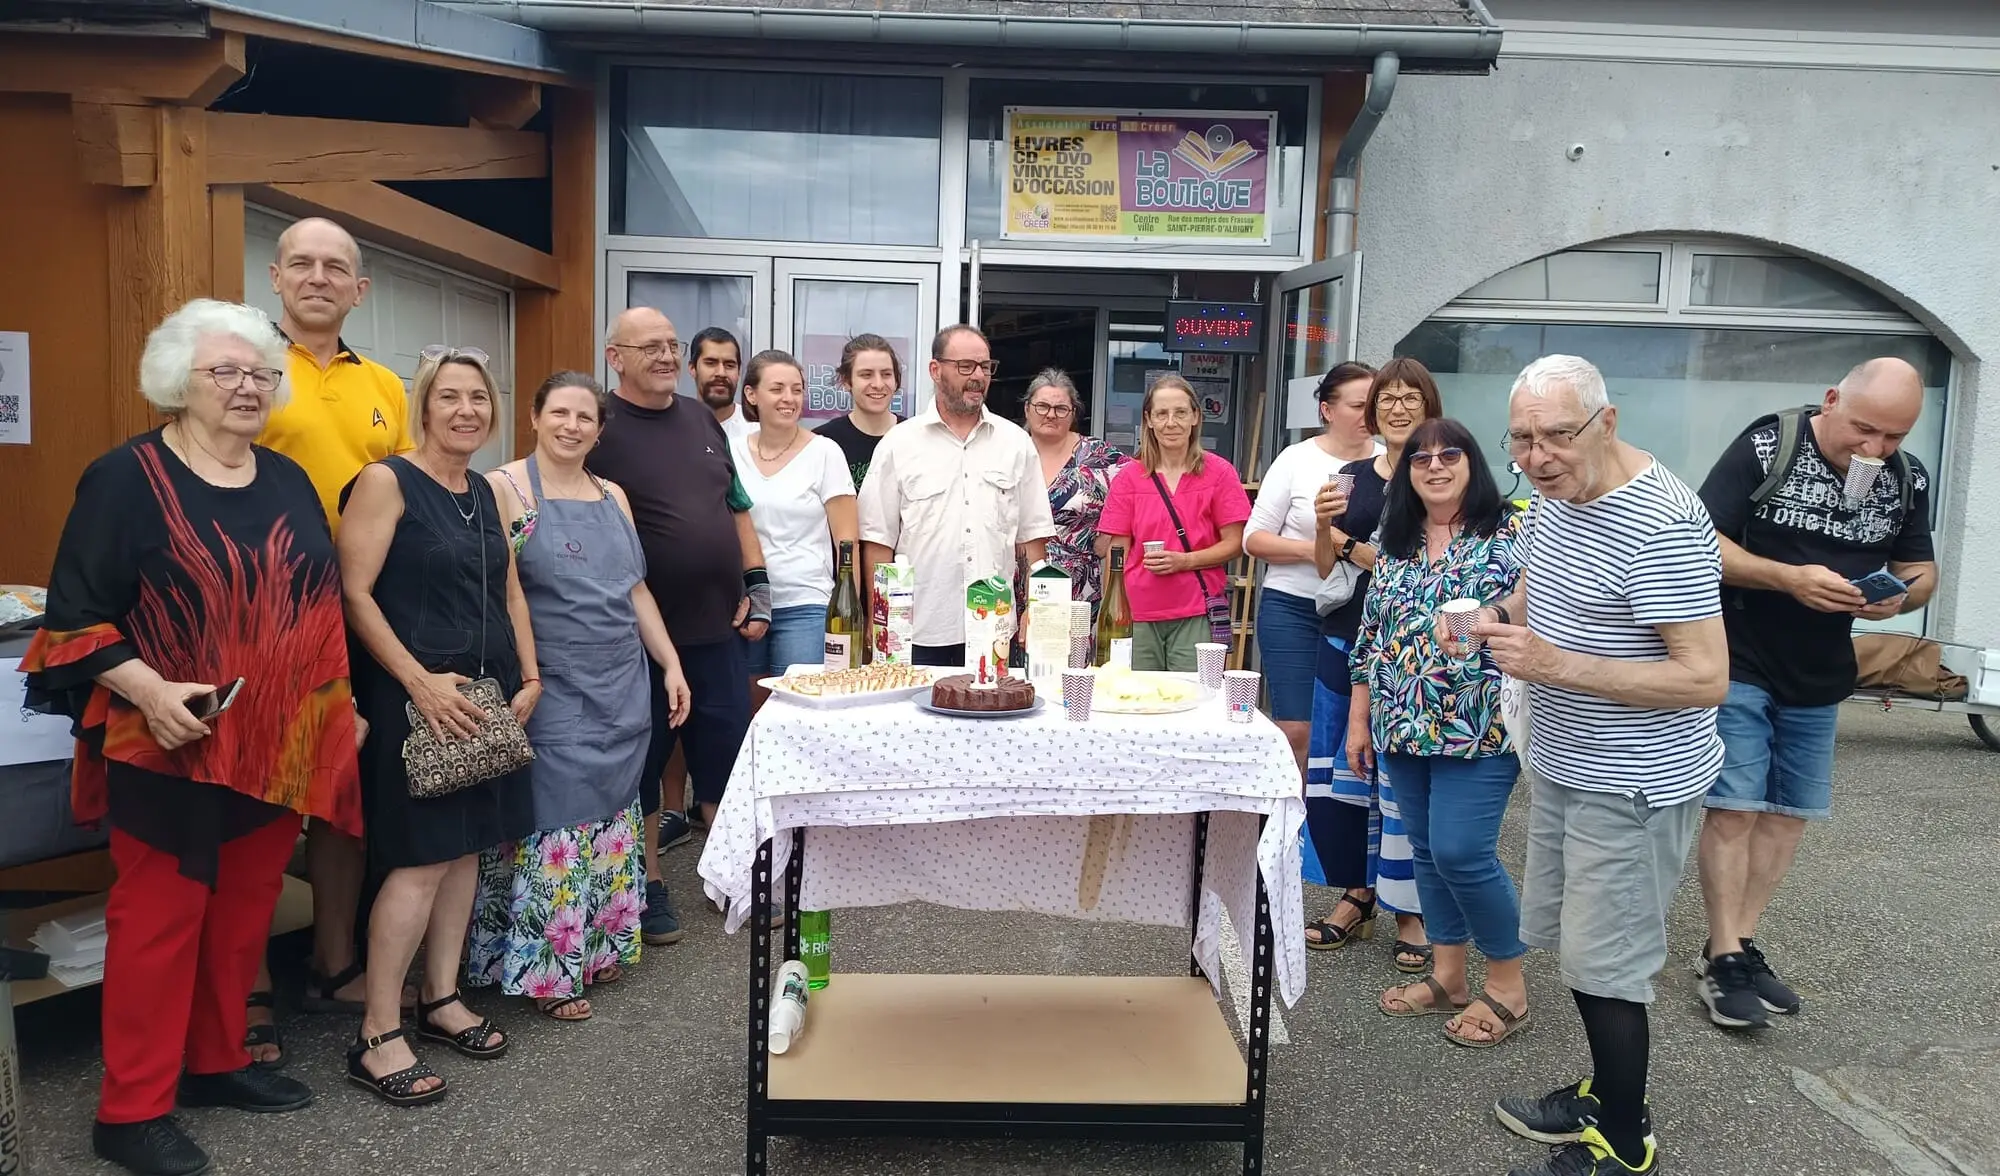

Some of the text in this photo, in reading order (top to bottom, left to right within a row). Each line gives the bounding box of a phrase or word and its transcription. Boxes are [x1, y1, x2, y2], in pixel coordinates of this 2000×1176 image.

[1094, 121, 1117, 130] Lire
[1014, 135, 1084, 151] LIVRES
[1014, 151, 1038, 164] CD
[1056, 152, 1092, 165] DVD
[1137, 150, 1171, 178] La
[1013, 165, 1085, 179] VINYLES
[1013, 178, 1115, 195] D'OCCASION
[1133, 214, 1160, 224] Centre
[1167, 214, 1180, 222] Rue
[1193, 215, 1217, 224] martyrs
[1137, 222, 1155, 232] ville
[1167, 223, 1254, 233] SAINT-PIERRE-D'ALBIGNY
[1176, 319, 1253, 336] OUVERT
[1190, 354, 1226, 364] SAVOIE
[1197, 366, 1218, 375] 1945
